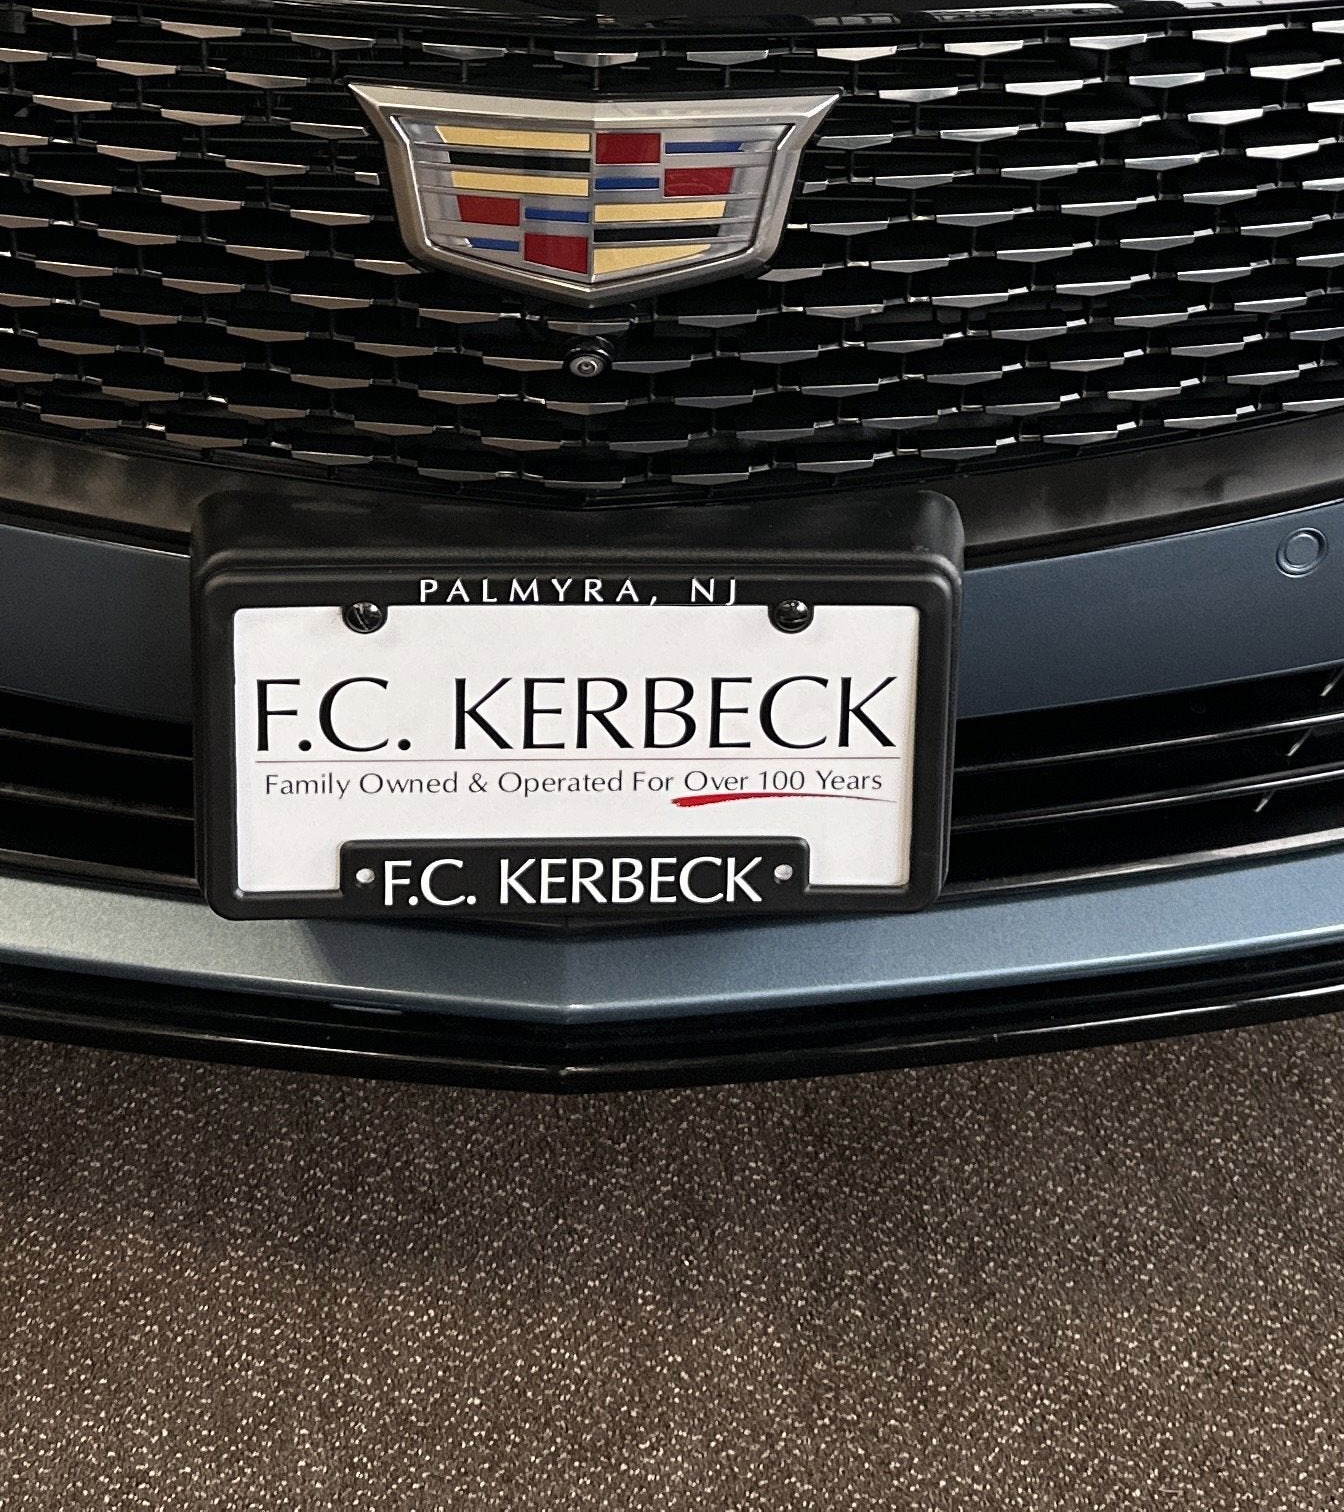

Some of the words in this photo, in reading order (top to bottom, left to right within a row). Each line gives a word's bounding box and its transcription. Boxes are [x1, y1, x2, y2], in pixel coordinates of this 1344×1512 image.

[419, 577, 658, 606] PALMYRA,
[690, 577, 738, 606] NJ
[256, 676, 411, 753] F.C.
[454, 675, 898, 750] KERBECK
[265, 772, 351, 801] Family
[359, 771, 458, 794] Owned
[468, 771, 488, 794] &
[498, 769, 623, 798] Operated
[633, 770, 674, 792] For
[684, 770, 749, 792] Over
[760, 770, 805, 791] 100
[815, 770, 883, 791] Years
[384, 859, 477, 906] F.C.
[499, 856, 763, 904] KERBECK
